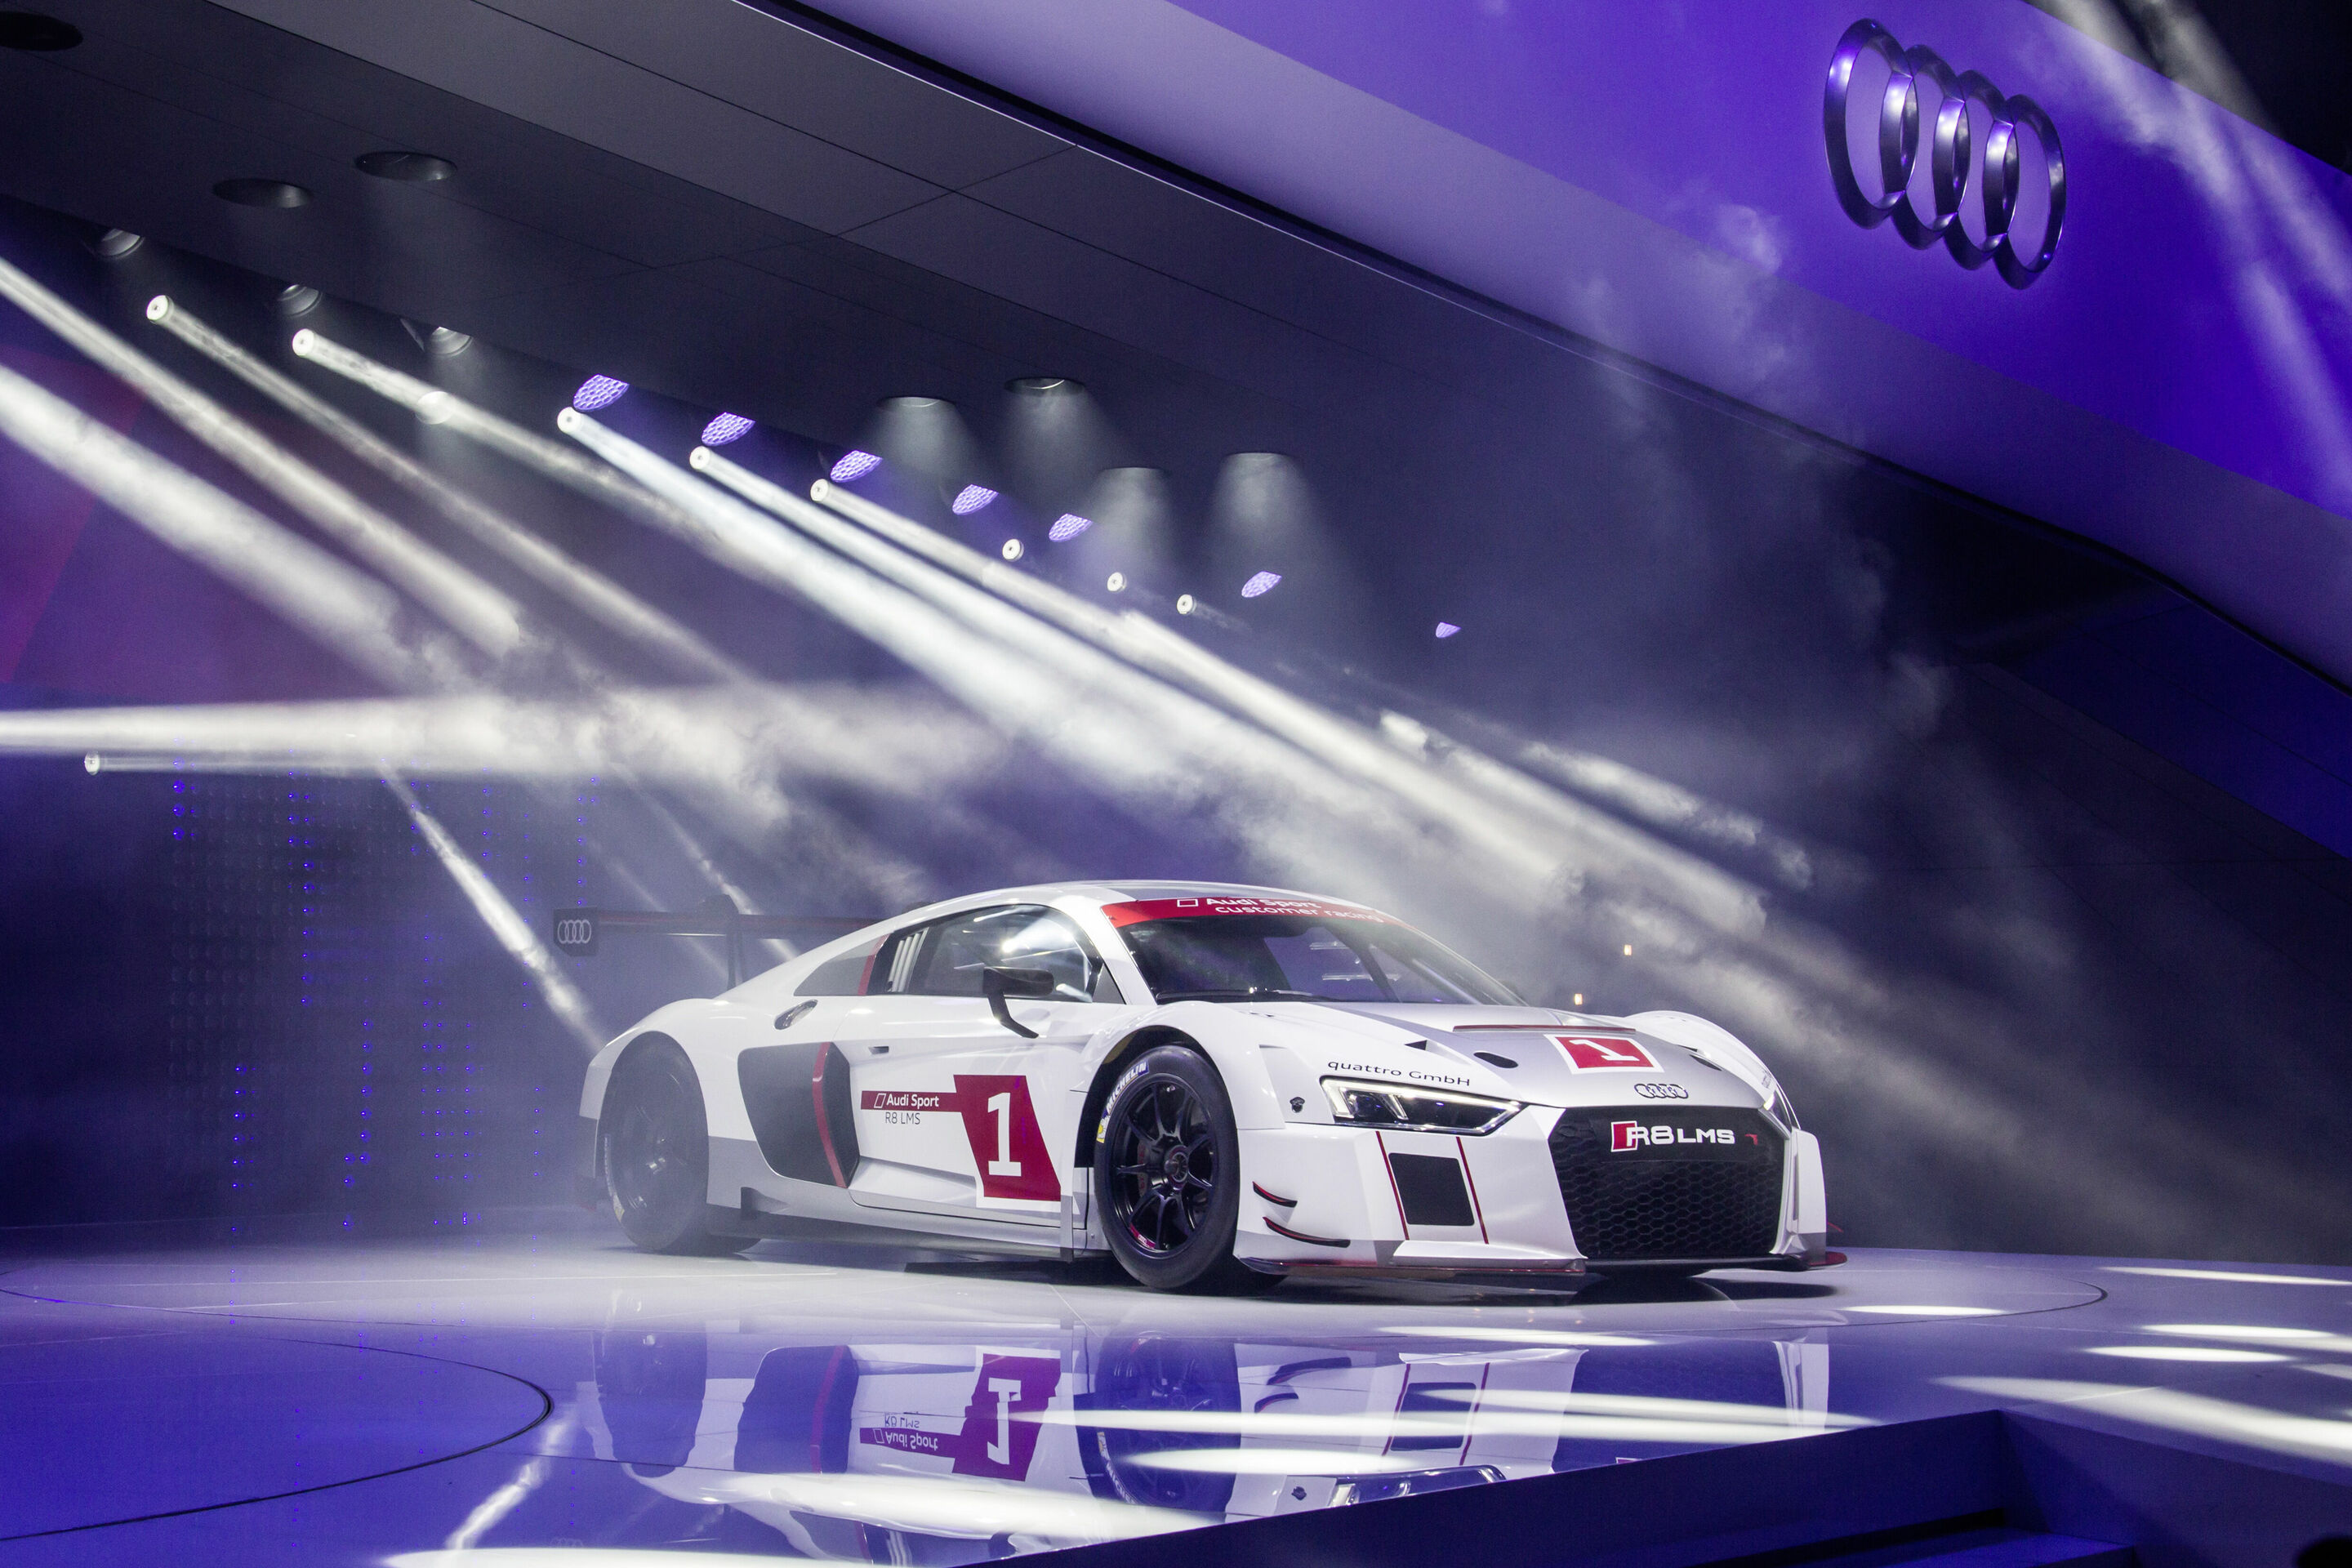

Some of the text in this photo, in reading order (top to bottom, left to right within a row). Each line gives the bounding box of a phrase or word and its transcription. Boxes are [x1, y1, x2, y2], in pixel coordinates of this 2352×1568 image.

[1258, 899, 1321, 908] Sport
[1215, 906, 1384, 922] customer racing
[1569, 1040, 1640, 1062] 1
[1327, 1061, 1470, 1086] quattro GmbH
[1106, 1061, 1147, 1115] MICHELIN
[886, 1094, 939, 1109] Audi Sport
[885, 1111, 920, 1125] R8 LMS
[987, 1092, 1022, 1177] 1
